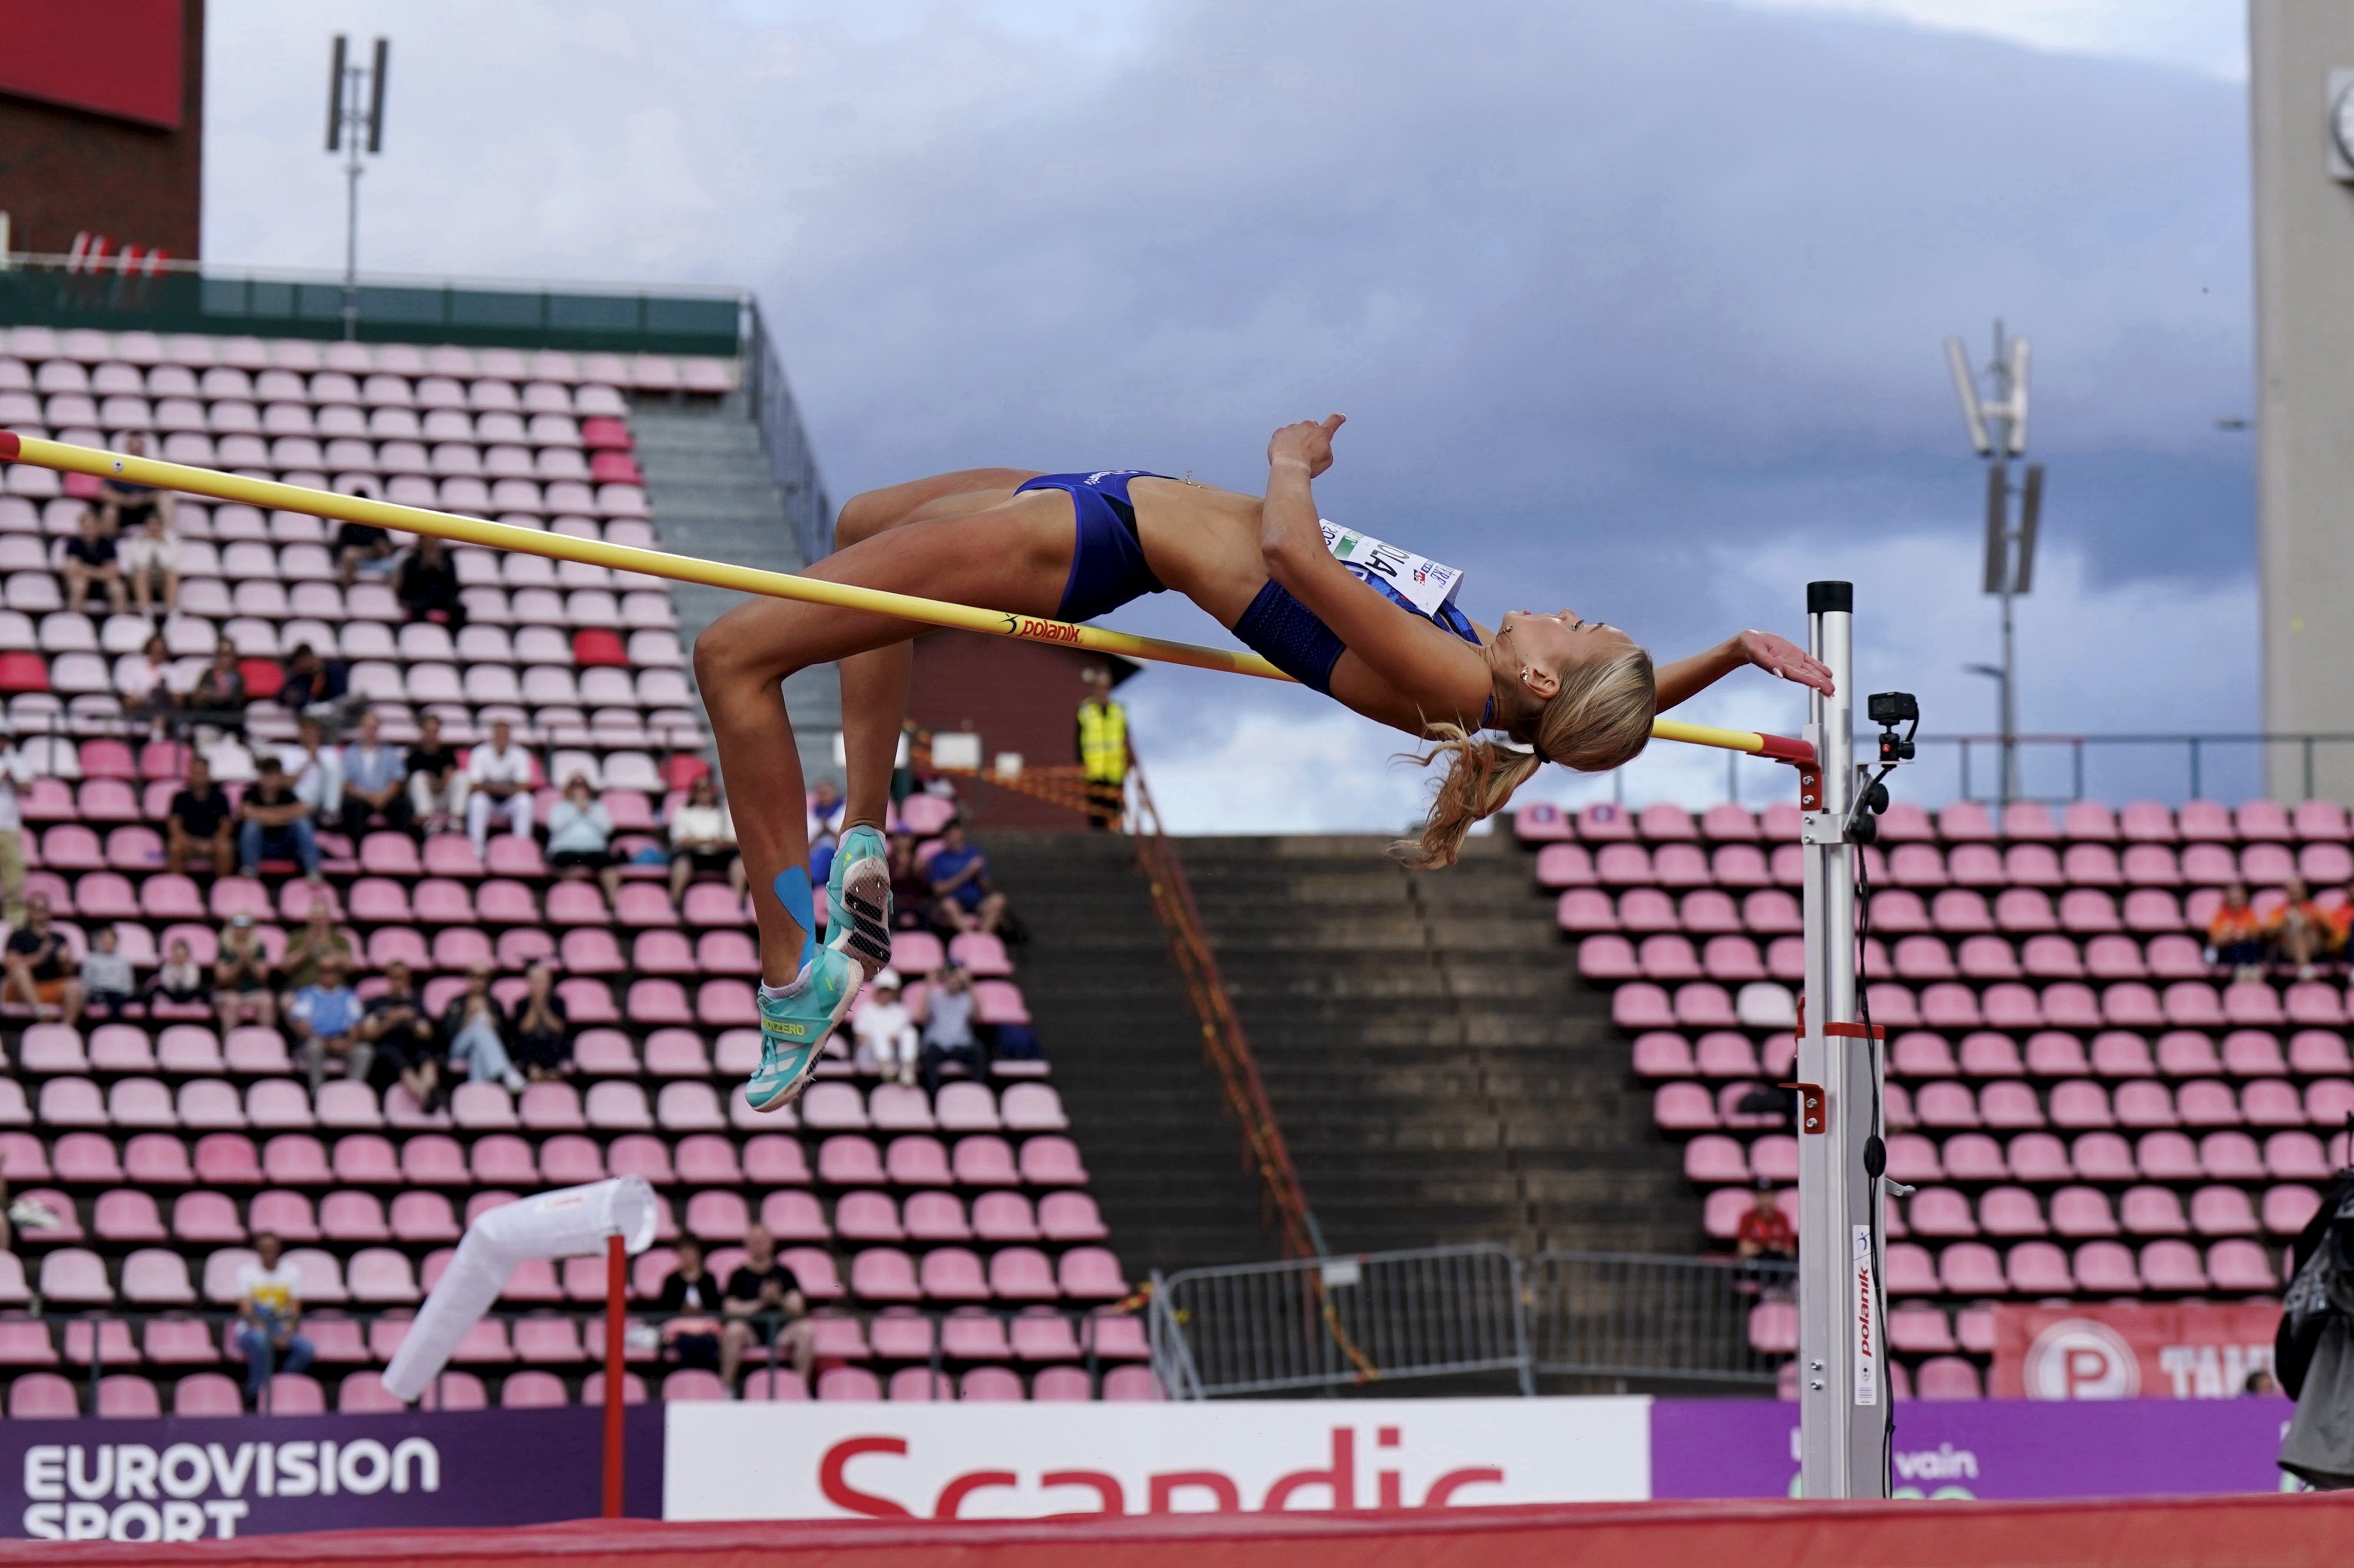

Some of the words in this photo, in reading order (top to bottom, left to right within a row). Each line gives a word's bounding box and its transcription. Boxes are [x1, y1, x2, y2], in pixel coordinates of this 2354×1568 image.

[1364, 542, 1410, 578] OLA
[1017, 620, 1081, 643] polanik
[1858, 1265, 1872, 1358] polanik
[22, 1437, 441, 1501] EUROVISION
[22, 1499, 249, 1542] SPORT
